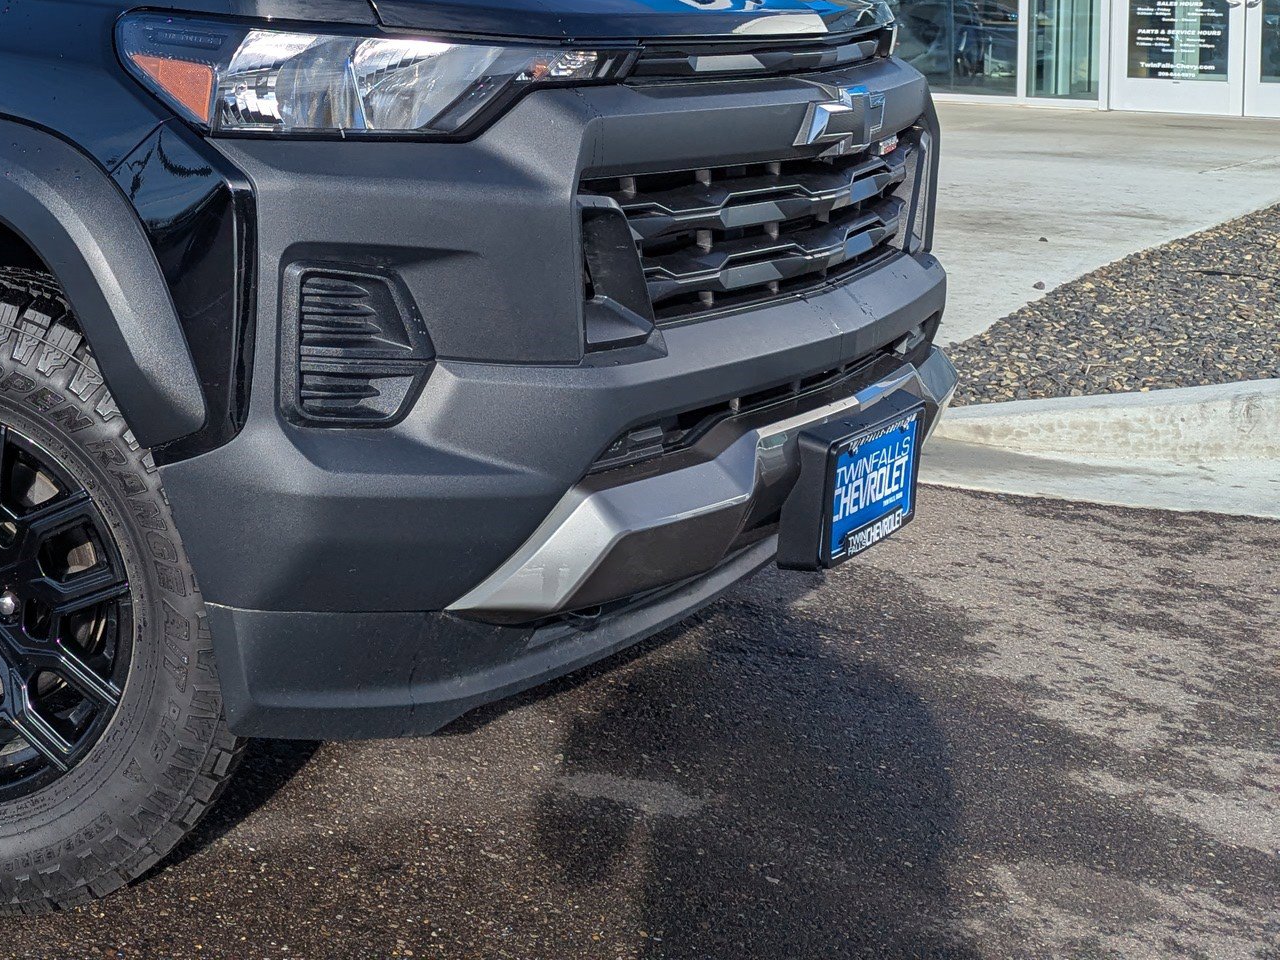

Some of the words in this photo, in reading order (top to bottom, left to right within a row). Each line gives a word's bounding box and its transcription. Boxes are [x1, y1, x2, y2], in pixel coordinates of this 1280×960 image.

[836, 436, 911, 488] TWINFALLS
[832, 455, 909, 523] CHEVROLET
[84, 439, 186, 598] RANGE
[848, 529, 867, 548] TWIN
[866, 508, 904, 547] CHEVROLET
